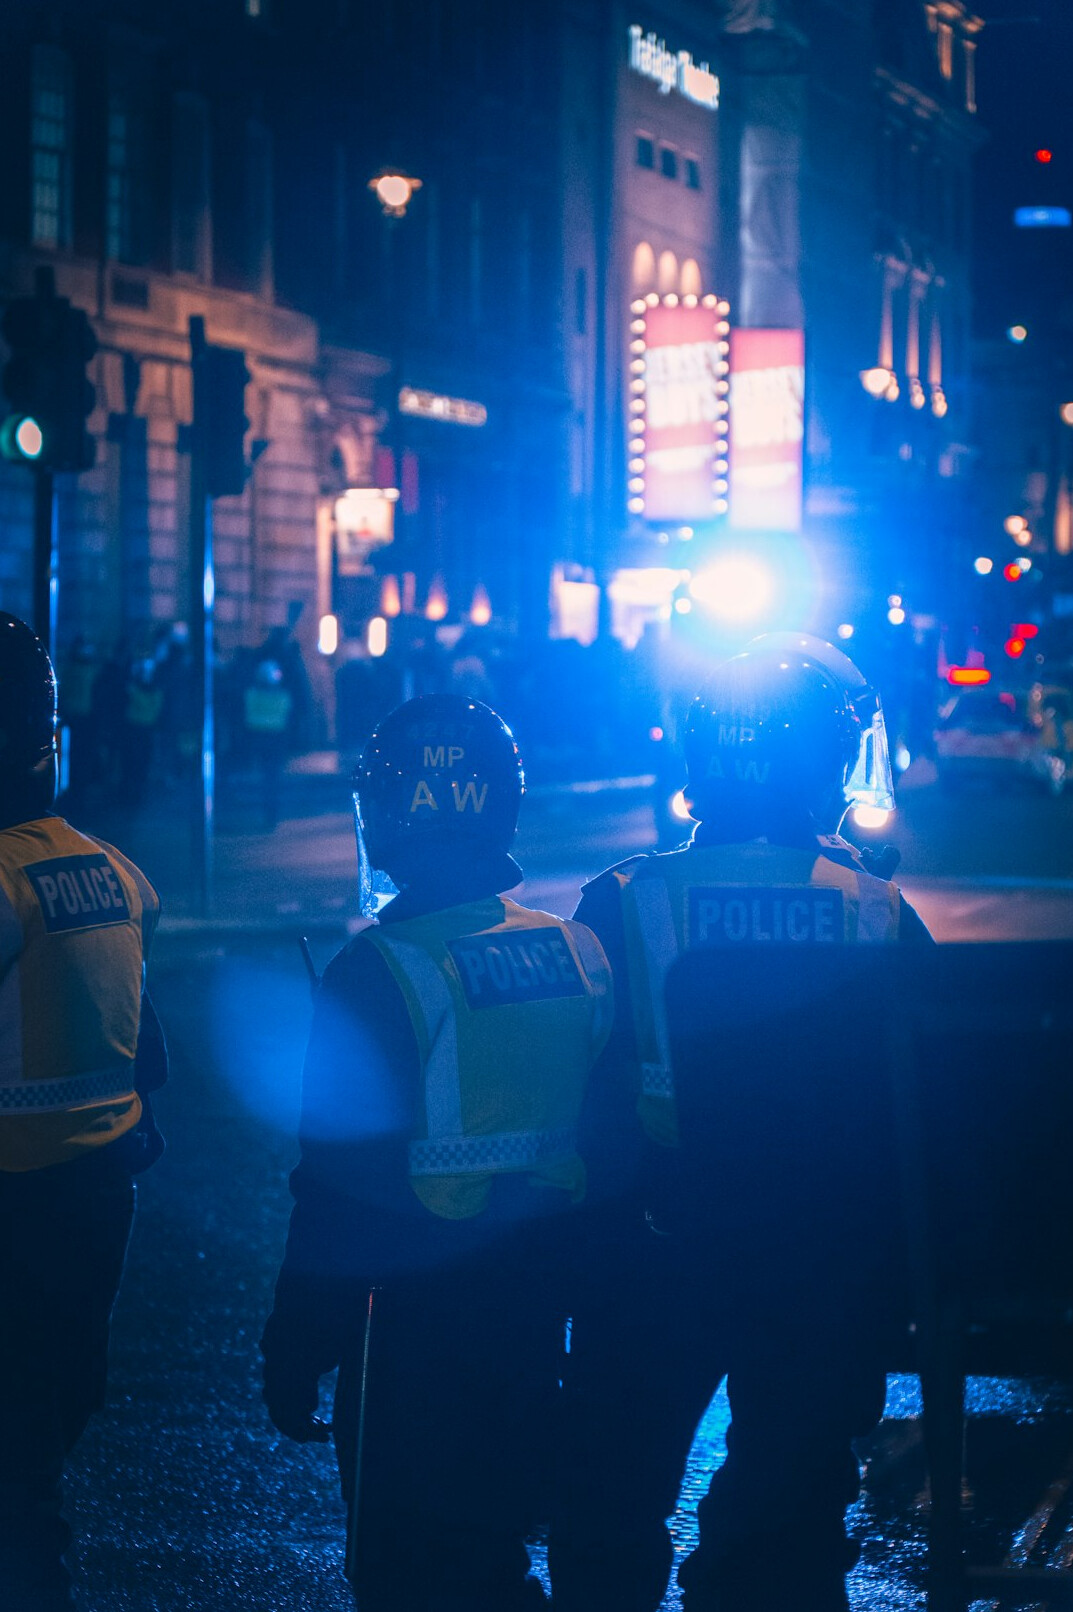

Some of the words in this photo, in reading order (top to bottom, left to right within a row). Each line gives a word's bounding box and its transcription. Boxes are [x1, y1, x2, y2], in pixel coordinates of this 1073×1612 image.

[718, 725, 755, 747] MP
[423, 746, 464, 768] MP
[410, 780, 439, 813] A
[451, 780, 488, 814] W
[37, 866, 123, 918] POLICE
[698, 899, 834, 942] POLICE
[461, 941, 577, 994] POLICE
